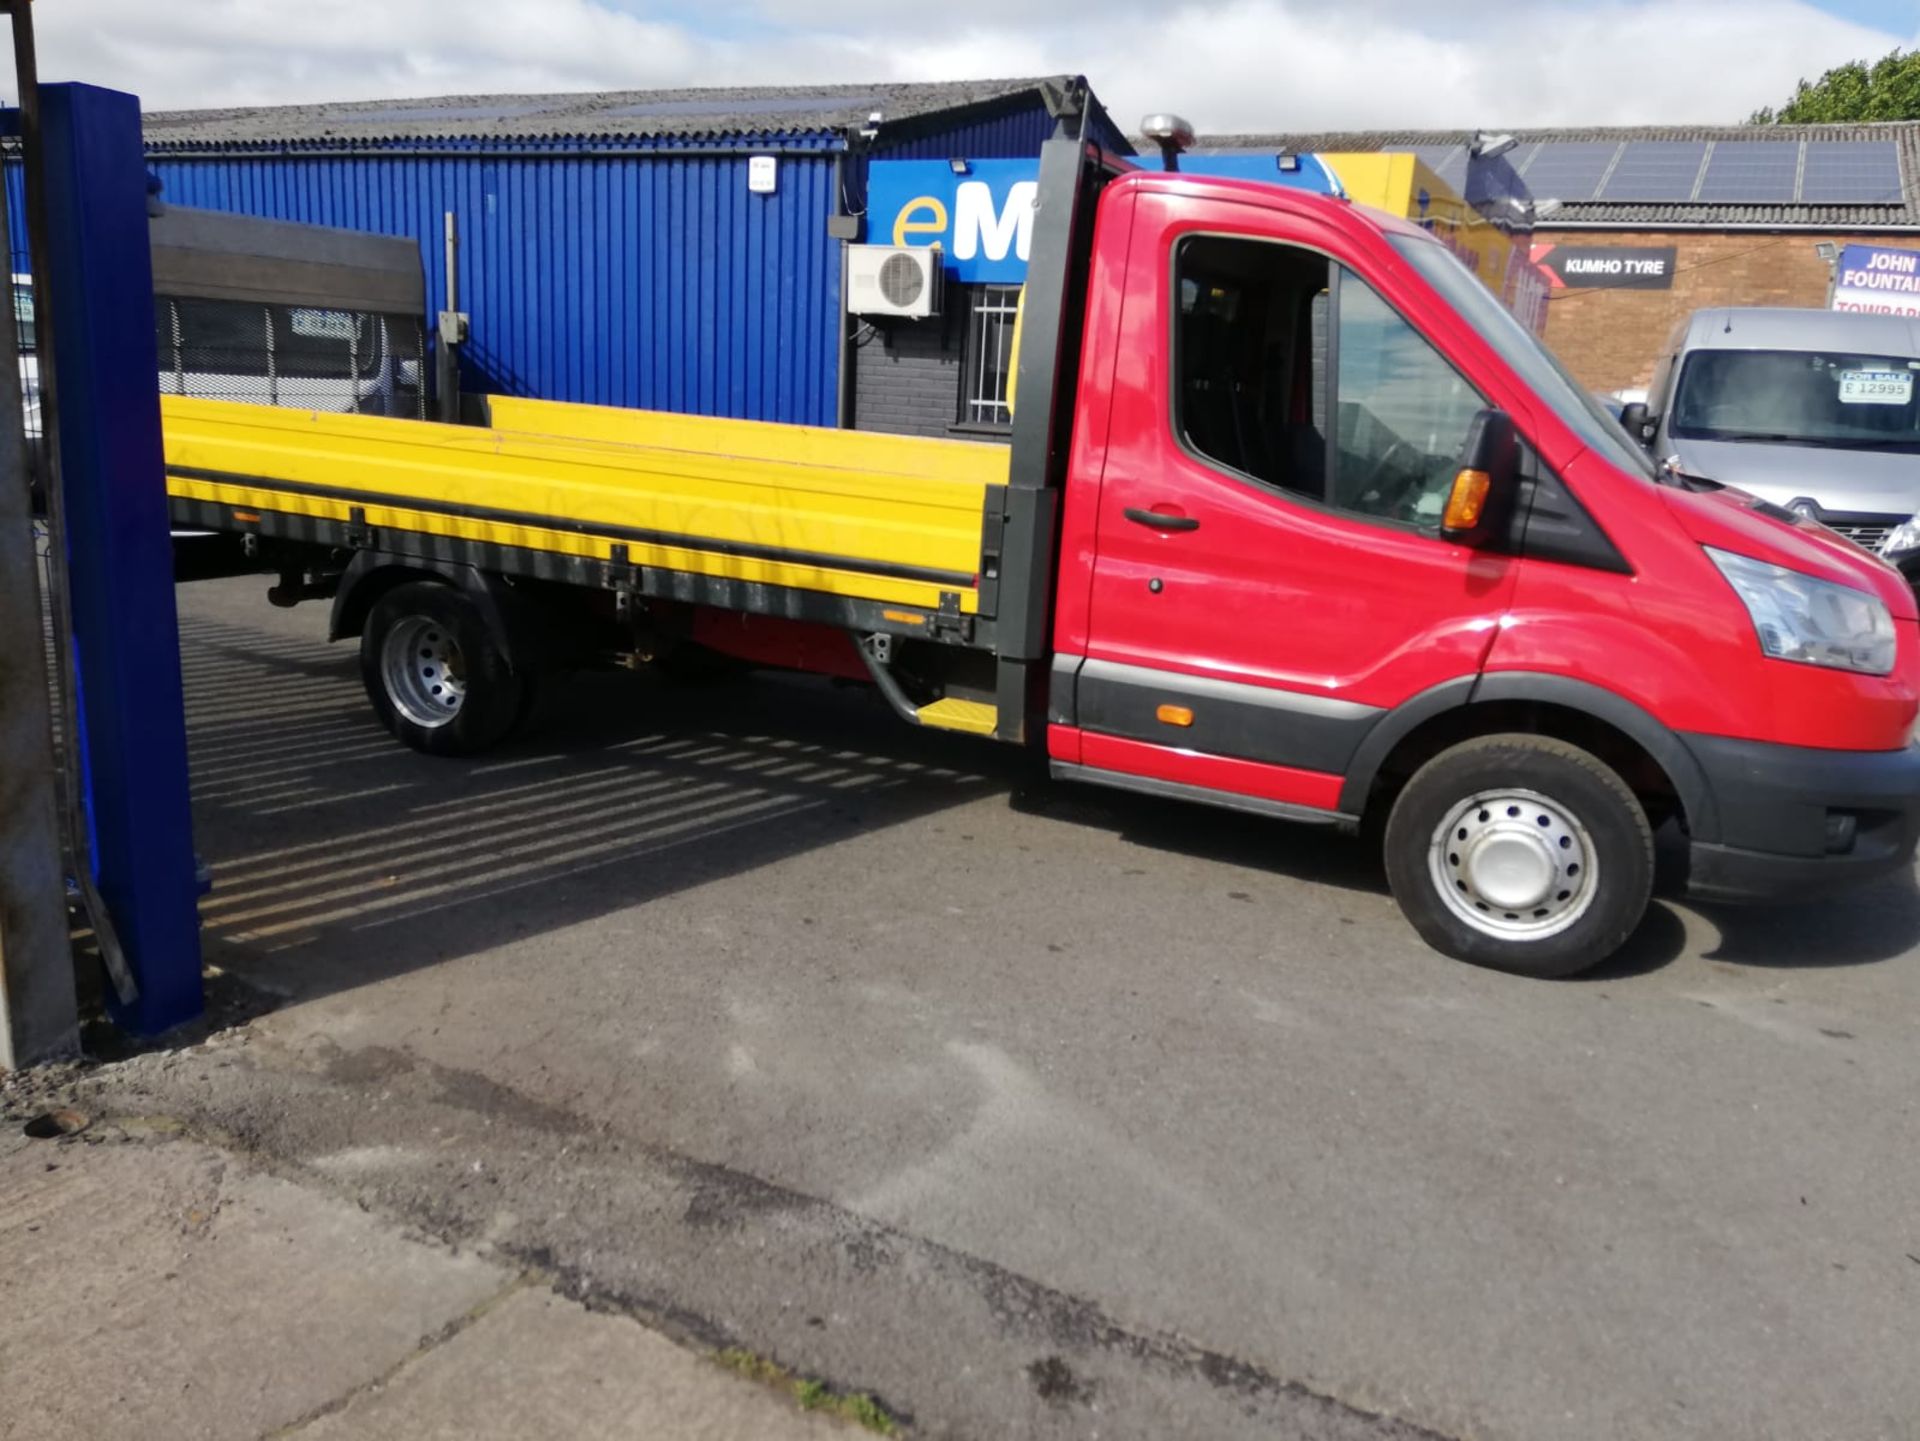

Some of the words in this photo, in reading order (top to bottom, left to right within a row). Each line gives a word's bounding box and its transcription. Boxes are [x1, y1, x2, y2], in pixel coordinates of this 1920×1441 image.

[1564, 258, 1621, 274] KUMHO
[1624, 260, 1665, 275] TYRE
[1866, 252, 1917, 273] JOHN
[1859, 383, 1906, 395] 12995
